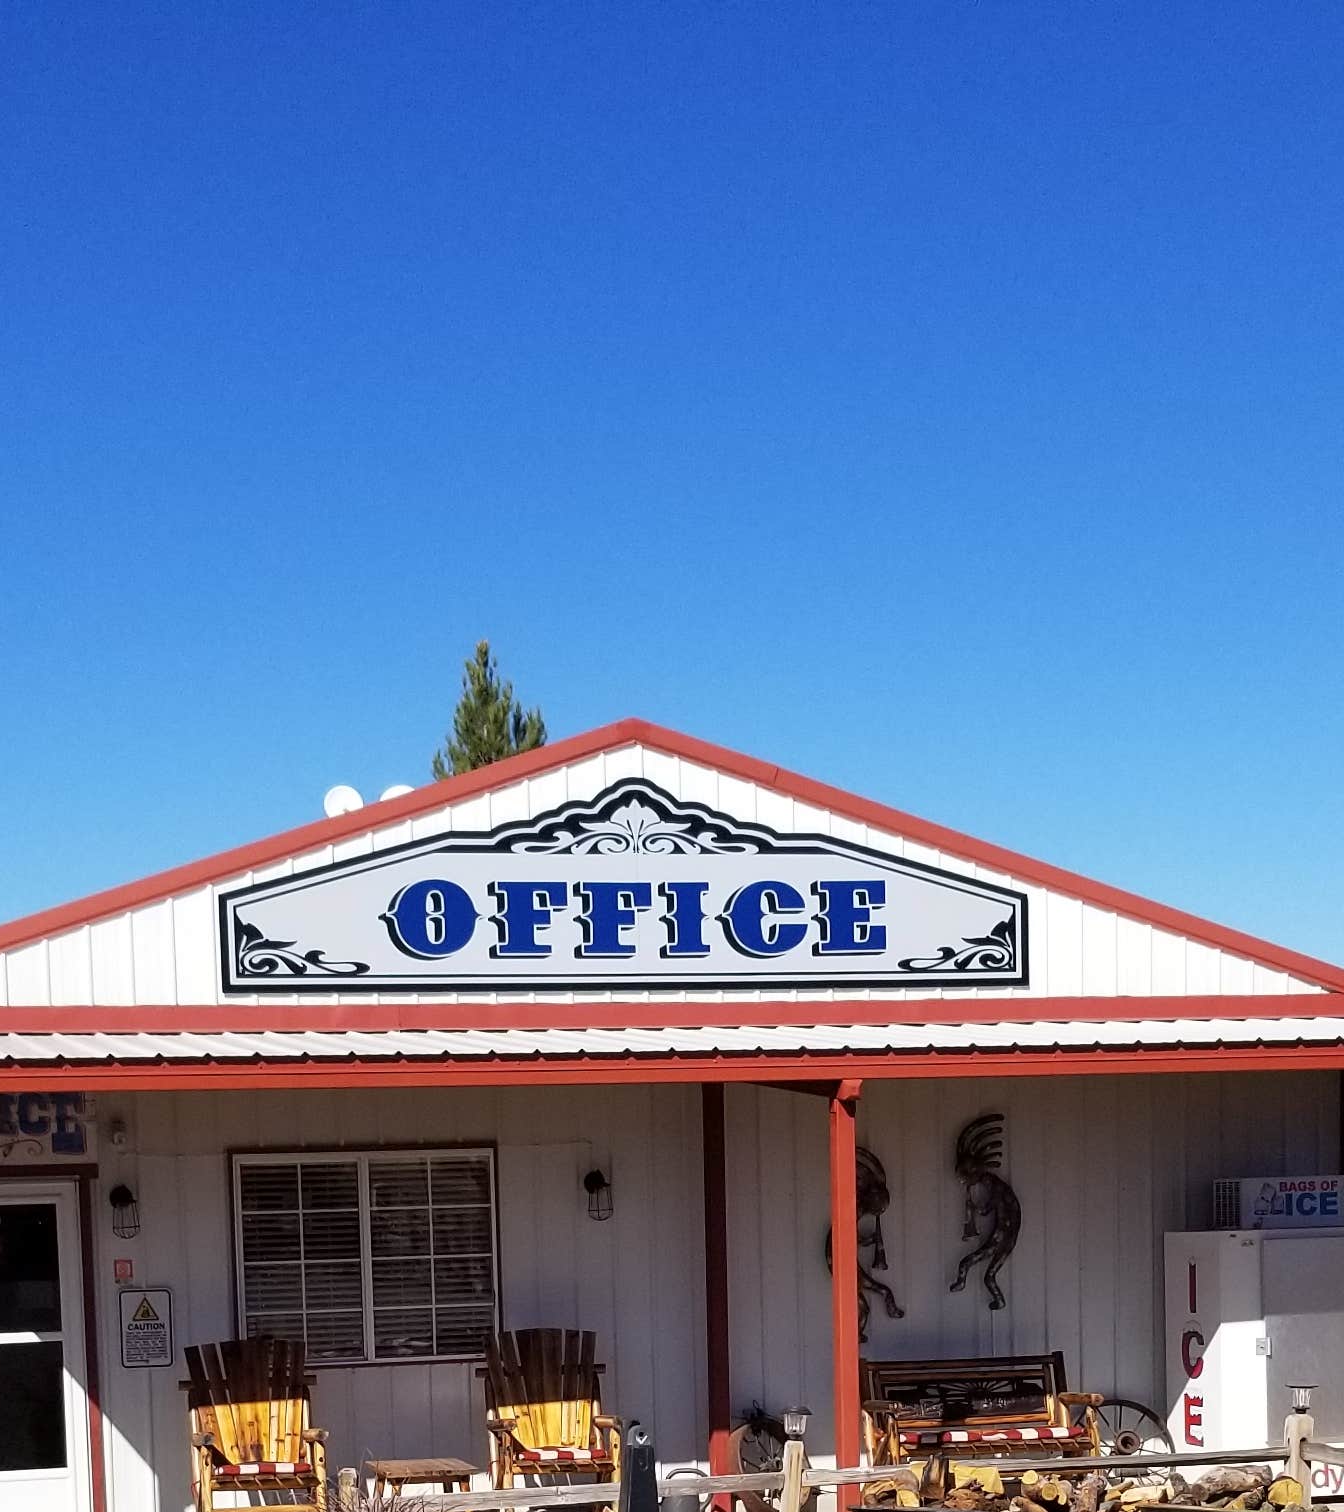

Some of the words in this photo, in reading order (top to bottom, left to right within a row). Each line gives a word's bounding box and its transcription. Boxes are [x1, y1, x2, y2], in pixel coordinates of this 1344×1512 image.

[377, 878, 887, 959] OFFICE
[1279, 1181, 1317, 1193] BAGS
[1320, 1179, 1339, 1191] OF
[1284, 1191, 1339, 1216] ICE
[127, 1322, 166, 1332] CAUTION
[1181, 1262, 1205, 1448] ICE
